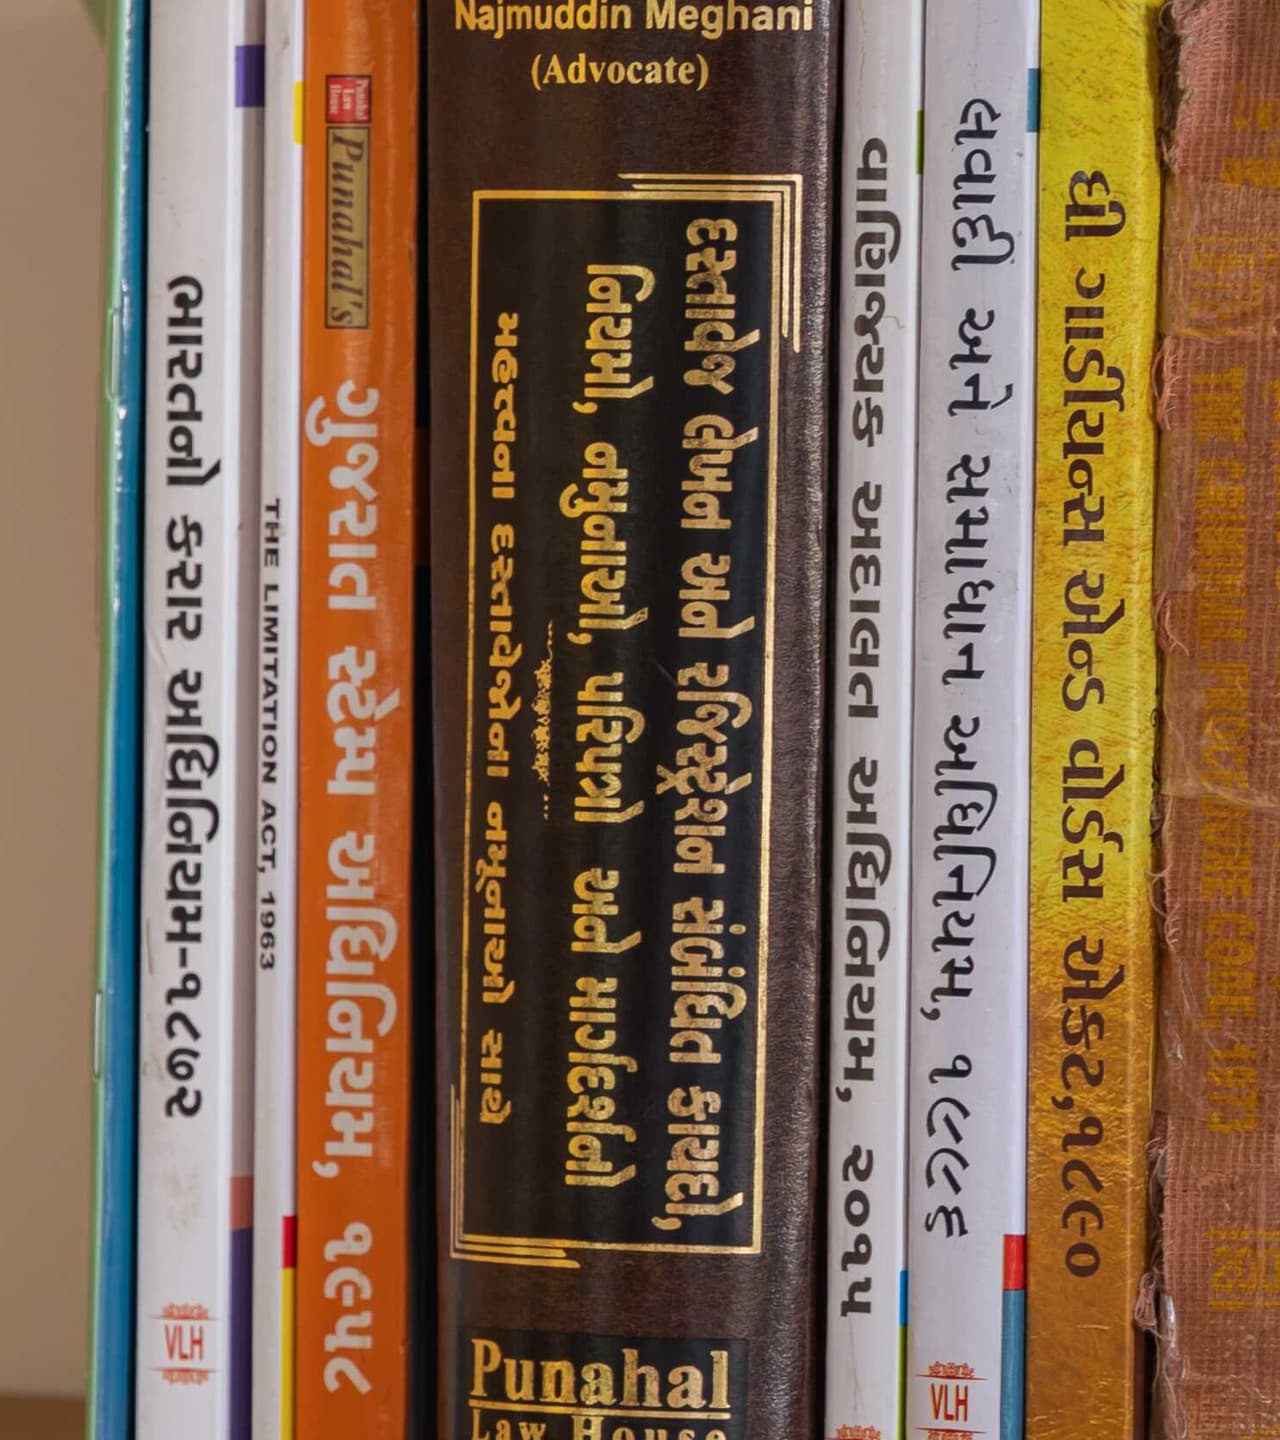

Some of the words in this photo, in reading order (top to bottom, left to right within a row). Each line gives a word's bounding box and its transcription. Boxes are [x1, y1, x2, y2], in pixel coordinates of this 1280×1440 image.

[531, 52, 709, 91] (Advocate)
[329, 132, 366, 323] Punahal's
[950, 98, 1015, 272] લવાદી
[166, 275, 221, 487] ભારતનો
[571, 264, 656, 414] નિયમો,
[683, 218, 761, 395] દસ્તાવેજ
[947, 307, 1014, 417] અને
[263, 497, 281, 567] THE
[304, 378, 380, 610] ગુજરાત
[563, 441, 649, 645] નમુનાઓ,
[680, 414, 760, 530] લેખન
[165, 514, 203, 641] કરાર
[486, 523, 523, 778] દસ્તાવેજોના
[678, 552, 756, 639] અને
[848, 480, 882, 719] અદાલત
[941, 454, 995, 686] સમાધાન
[1061, 569, 1126, 712] એન્ડ
[260, 583, 279, 784] LIMITATION
[326, 645, 400, 795] સ્ટેમ્પ
[573, 671, 645, 824] પરિપત્રો
[656, 662, 753, 875] રજિસ્ટ્રેશન
[164, 668, 220, 1118] અધિનિયમ-૧૮૭૨
[257, 799, 277, 874] ACT,
[474, 801, 515, 1004] નમૂનાઓ
[570, 867, 642, 954] અને
[919, 714, 998, 1021] અધિનિયમ,
[259, 891, 276, 971] 1963
[311, 830, 398, 1178] અધિનિયમ,
[669, 896, 748, 1064] સંબંધિત
[833, 756, 892, 1103] અધિનિયમ,
[479, 1029, 512, 1125] સાથે
[564, 976, 638, 1188] માર્ગદર્શનો
[651, 1085, 745, 1231] કાયદો,
[924, 1054, 973, 1238] ૧૯૯૬
[323, 1221, 373, 1394] ૧૯૫૮
[840, 1144, 874, 1318] ૨૦૧૫
[165, 1326, 204, 1361] VLH
[470, 1338, 731, 1409] Punahal
[930, 1384, 968, 1422] VLH
